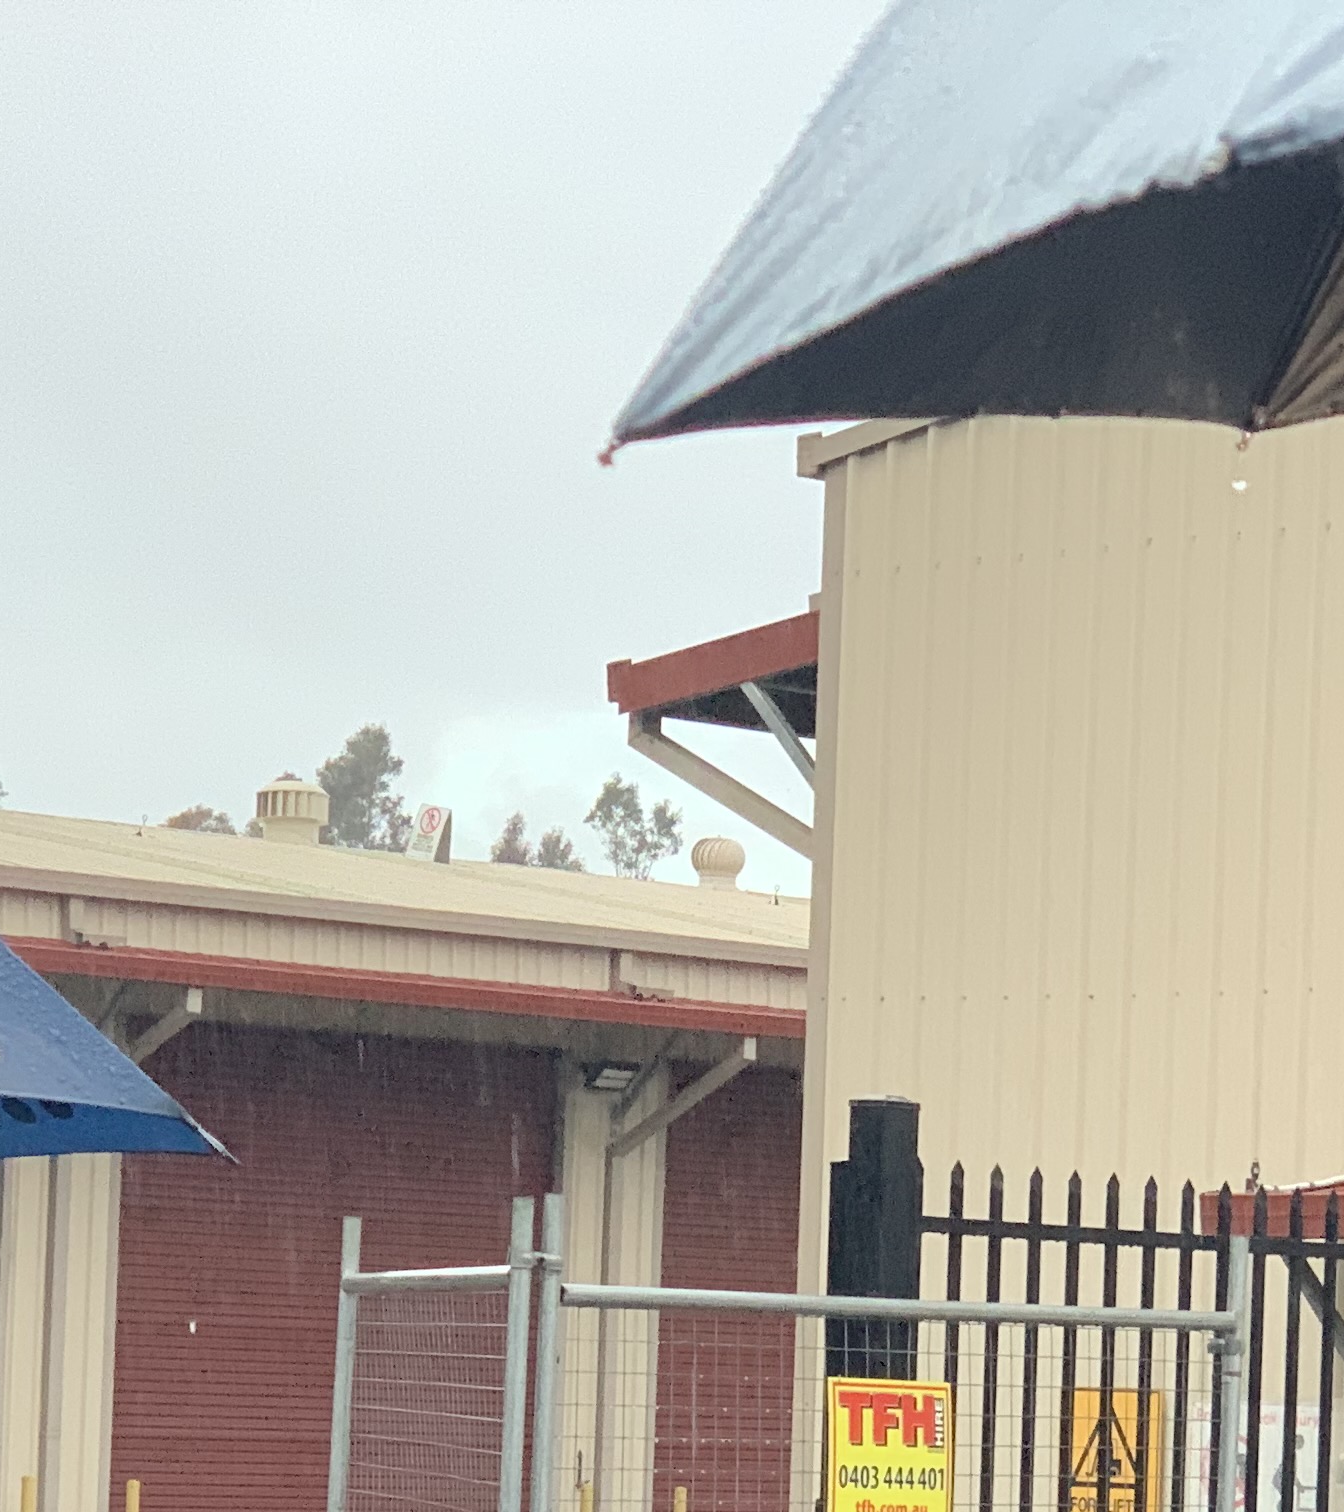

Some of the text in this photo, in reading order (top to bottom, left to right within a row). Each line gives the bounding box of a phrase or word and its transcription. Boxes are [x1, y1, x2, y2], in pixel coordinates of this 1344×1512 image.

[838, 1391, 936, 1447] TFH
[934, 1397, 945, 1447] HIRE
[838, 1464, 945, 1491] 0403 444 401
